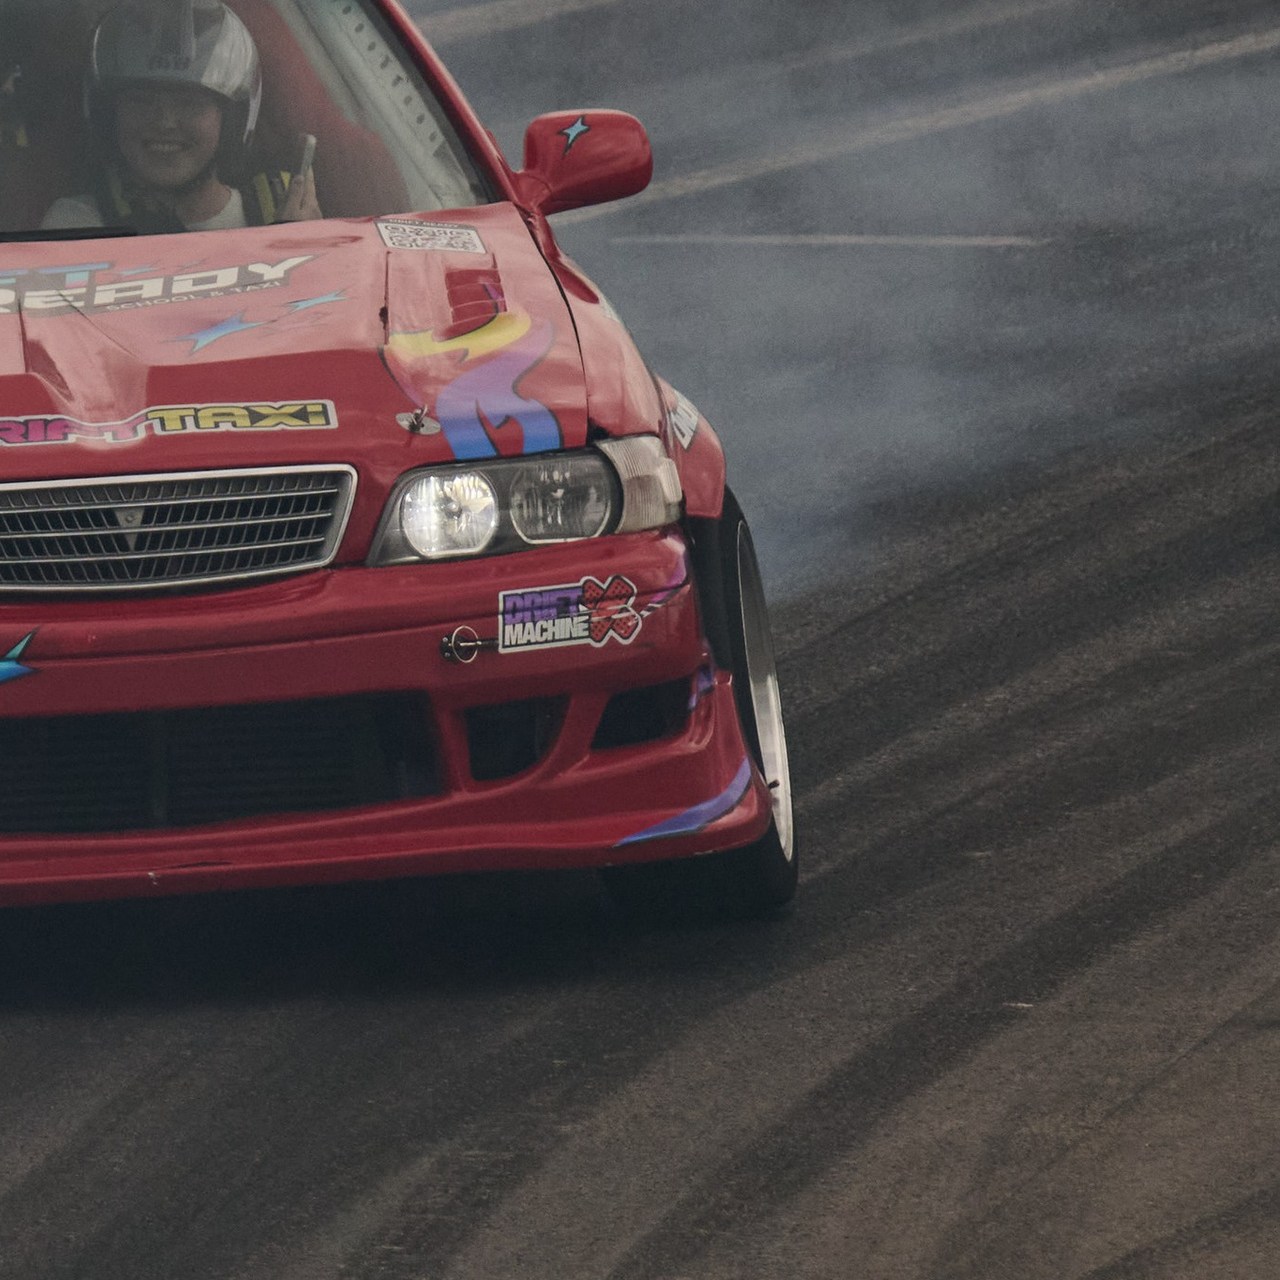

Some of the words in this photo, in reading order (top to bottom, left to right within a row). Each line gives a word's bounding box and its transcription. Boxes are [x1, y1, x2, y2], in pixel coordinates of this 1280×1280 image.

[106, 293, 201, 310] SCHOOL
[504, 587, 583, 625] DRIFT
[504, 615, 589, 646] MACHINE
